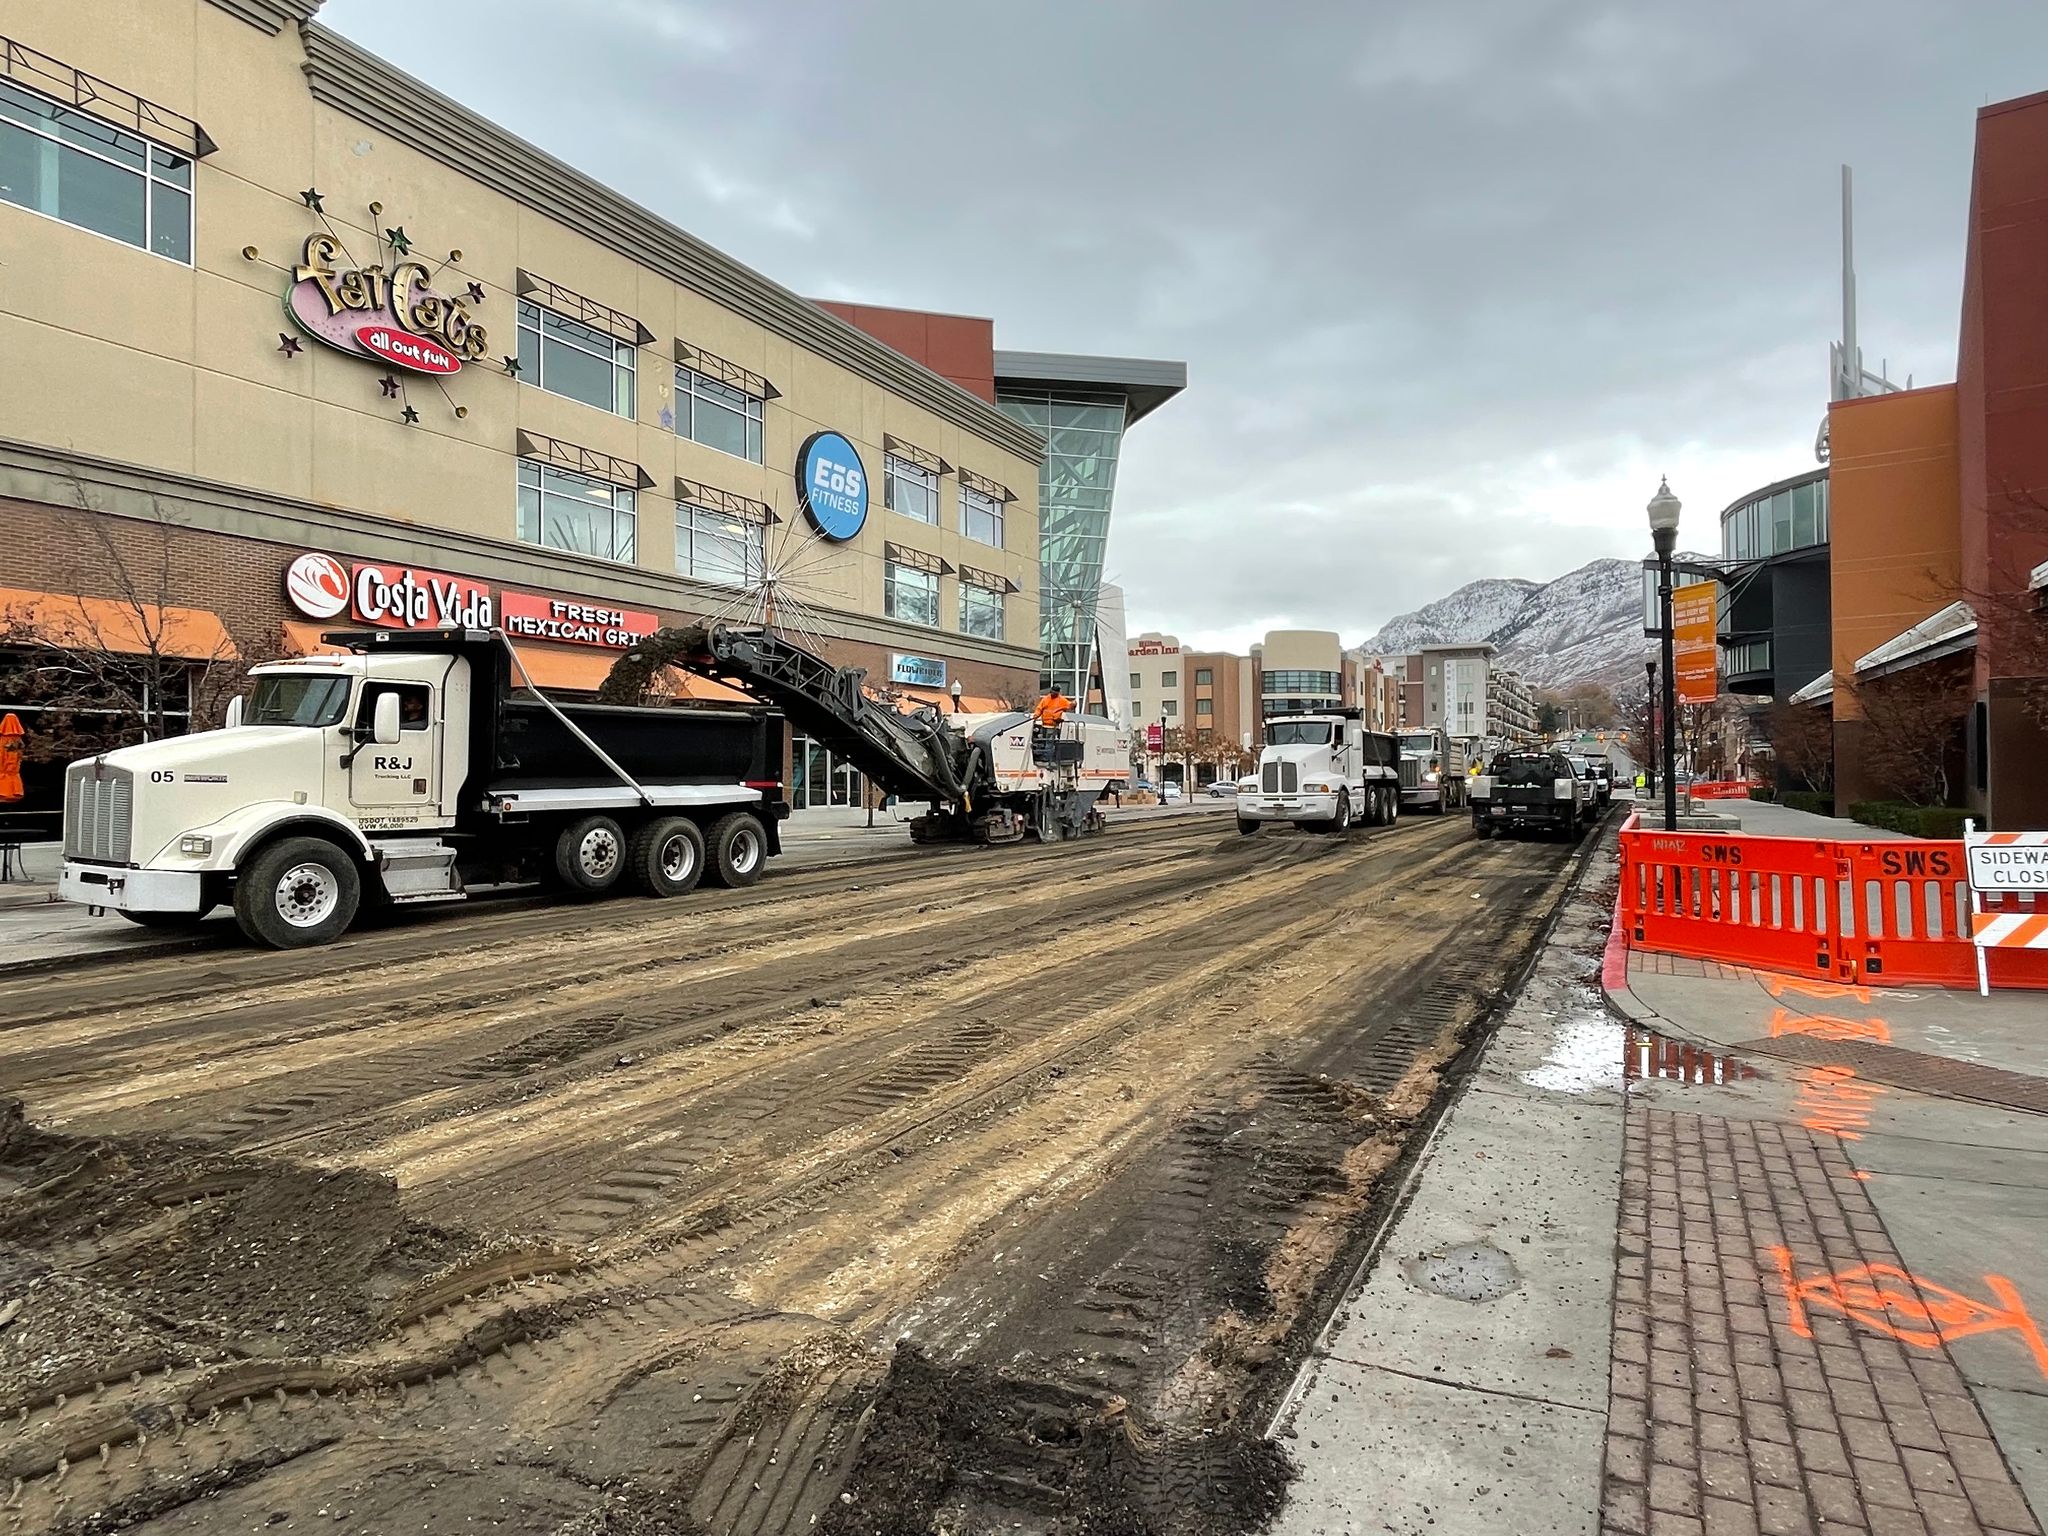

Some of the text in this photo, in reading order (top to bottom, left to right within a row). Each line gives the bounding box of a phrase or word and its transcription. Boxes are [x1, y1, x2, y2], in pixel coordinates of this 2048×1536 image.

[369, 331, 390, 351] all
[391, 340, 421, 361] out
[811, 488, 860, 516] FITNESS
[356, 567, 494, 629] Costa Vida
[550, 600, 625, 627] FRESH
[506, 615, 654, 648] MEXICAN GRI
[1127, 645, 1180, 656] arden Inn
[150, 770, 175, 783] 05
[374, 757, 413, 770] R&J
[1701, 844, 1742, 865] SWS
[1882, 850, 1951, 876] SWS
[1993, 870, 2048, 884] CLOS
